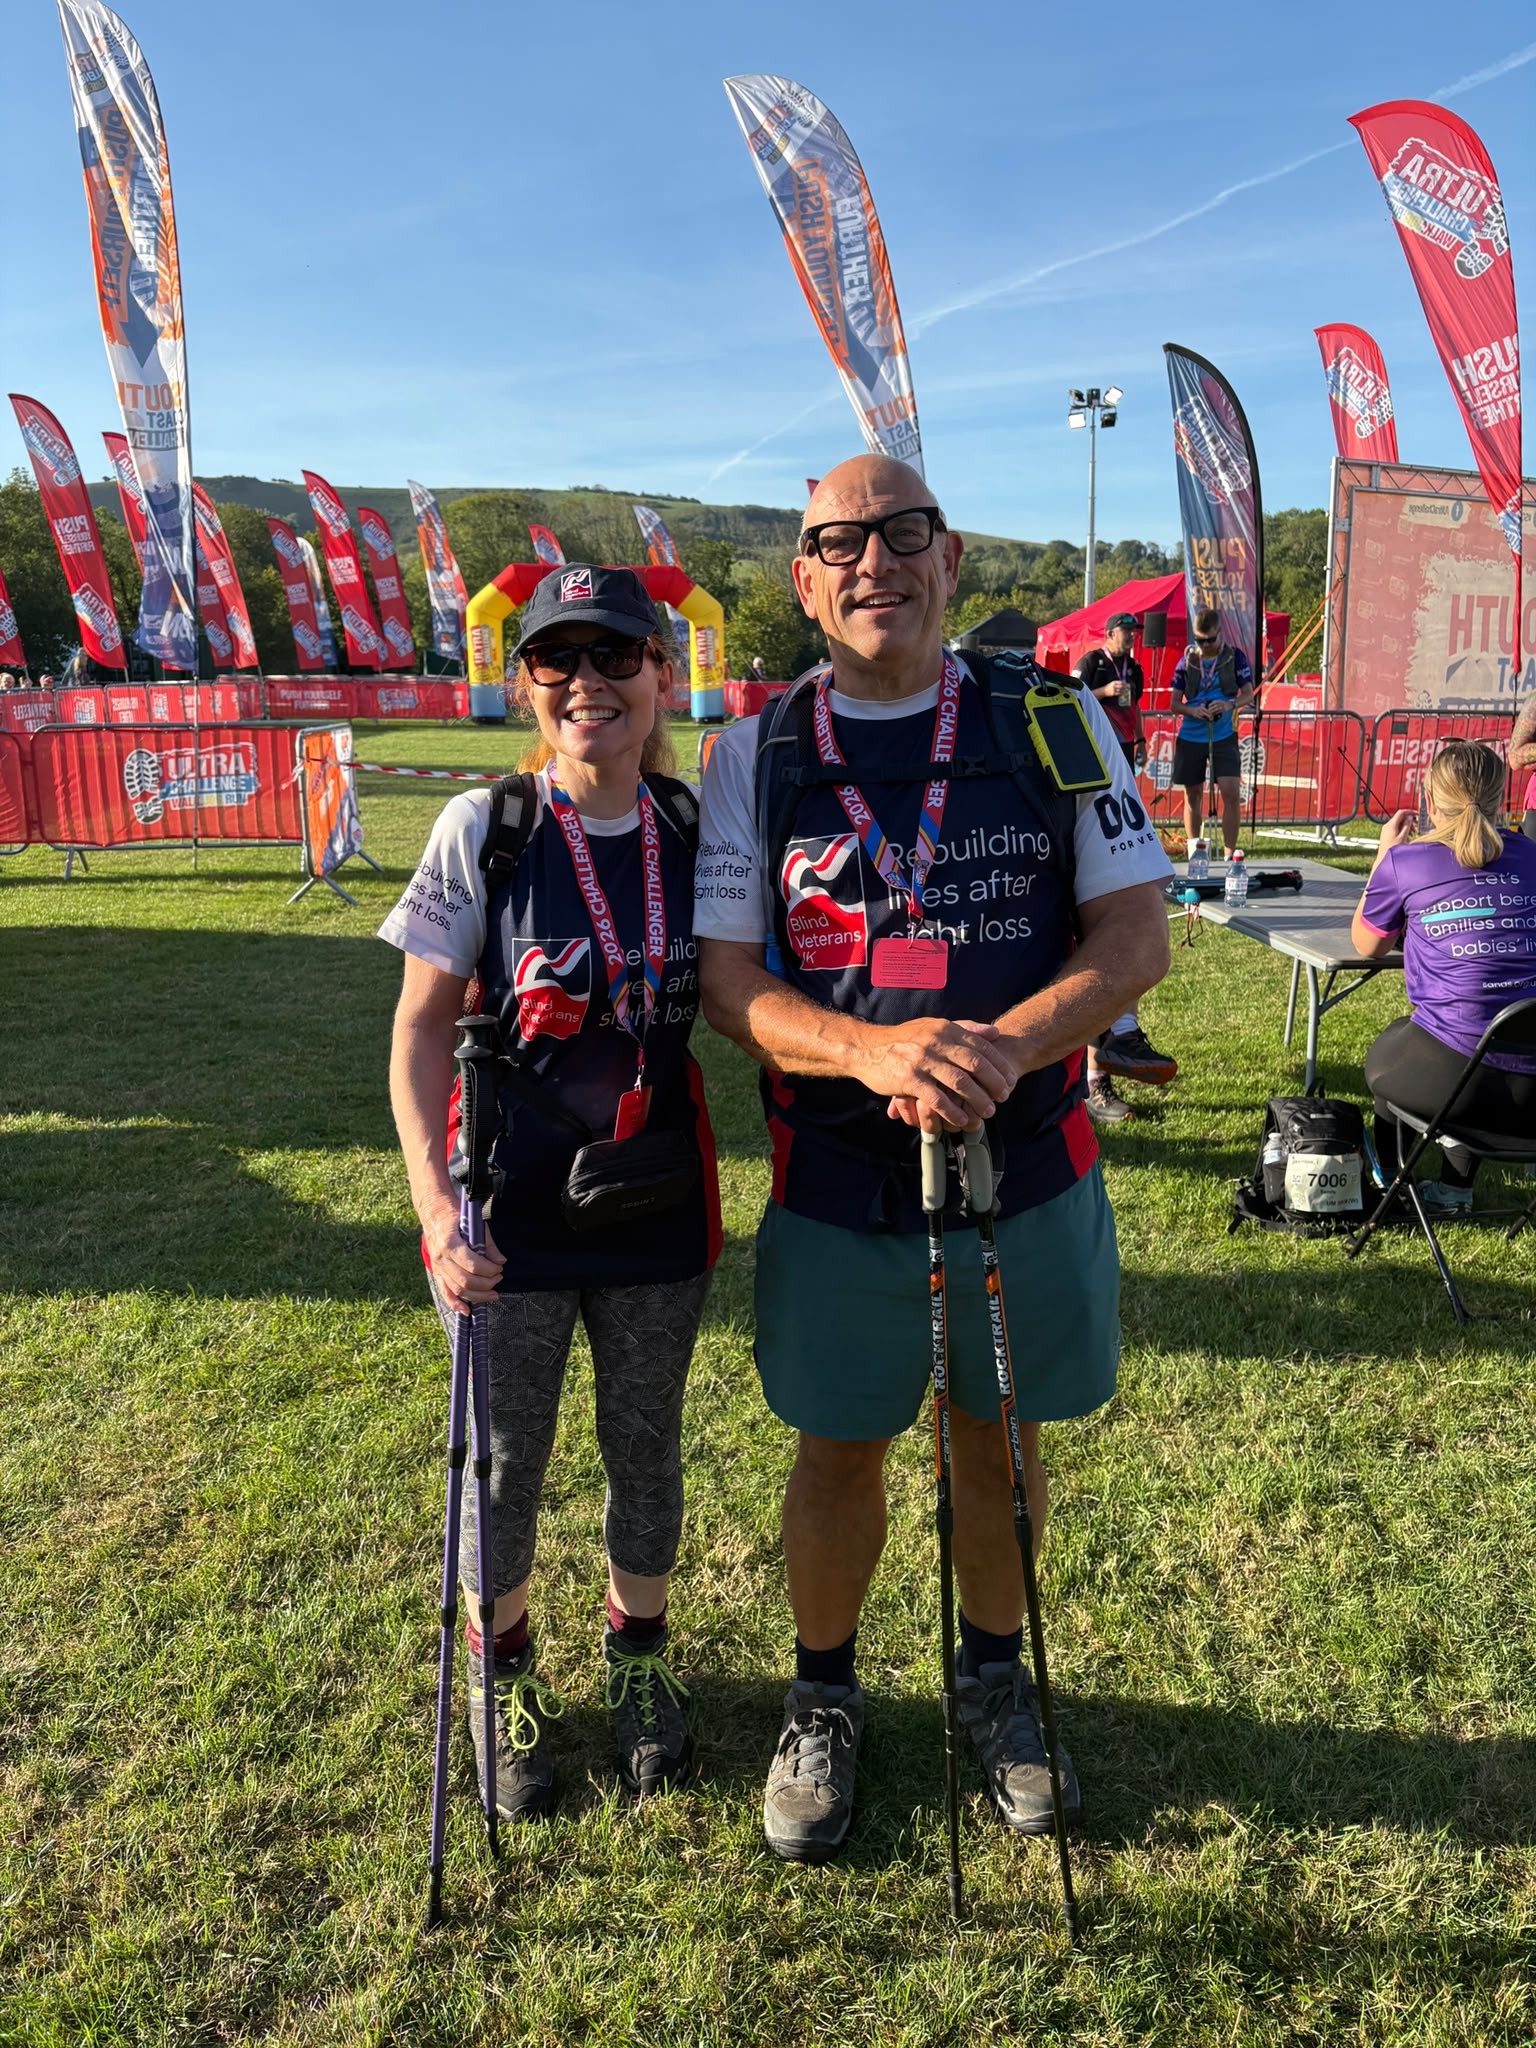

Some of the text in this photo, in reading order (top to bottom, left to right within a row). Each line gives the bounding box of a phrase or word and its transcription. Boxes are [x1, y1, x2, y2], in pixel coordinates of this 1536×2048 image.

[942, 659, 959, 698] 2026
[167, 752, 247, 780] ULTRA
[170, 777, 247, 794] CHALLENGE
[839, 785, 872, 826] 2026
[1110, 831, 1156, 855] FOR VE
[642, 801, 664, 958] 2026 CHALLENGER
[715, 862, 753, 879] after
[1472, 872, 1520, 885] Let's
[559, 808, 624, 967] 2026 CHALLENGER
[716, 882, 747, 900] loss
[969, 869, 1037, 902] after
[428, 889, 464, 916] after
[424, 905, 452, 931] loss
[790, 912, 829, 933] Blind
[978, 912, 1032, 943] loss
[1424, 918, 1495, 938] families
[794, 930, 862, 949] Veterans
[1451, 938, 1520, 957] babies'
[522, 997, 553, 1013] Blind
[1307, 1172, 1348, 1188] 7006
[930, 1291, 947, 1390] ROCKTRAIL
[988, 1294, 1012, 1395] ROCKTRAIL
[942, 1410, 951, 1464] carbon
[1008, 1415, 1025, 1471] carbon
